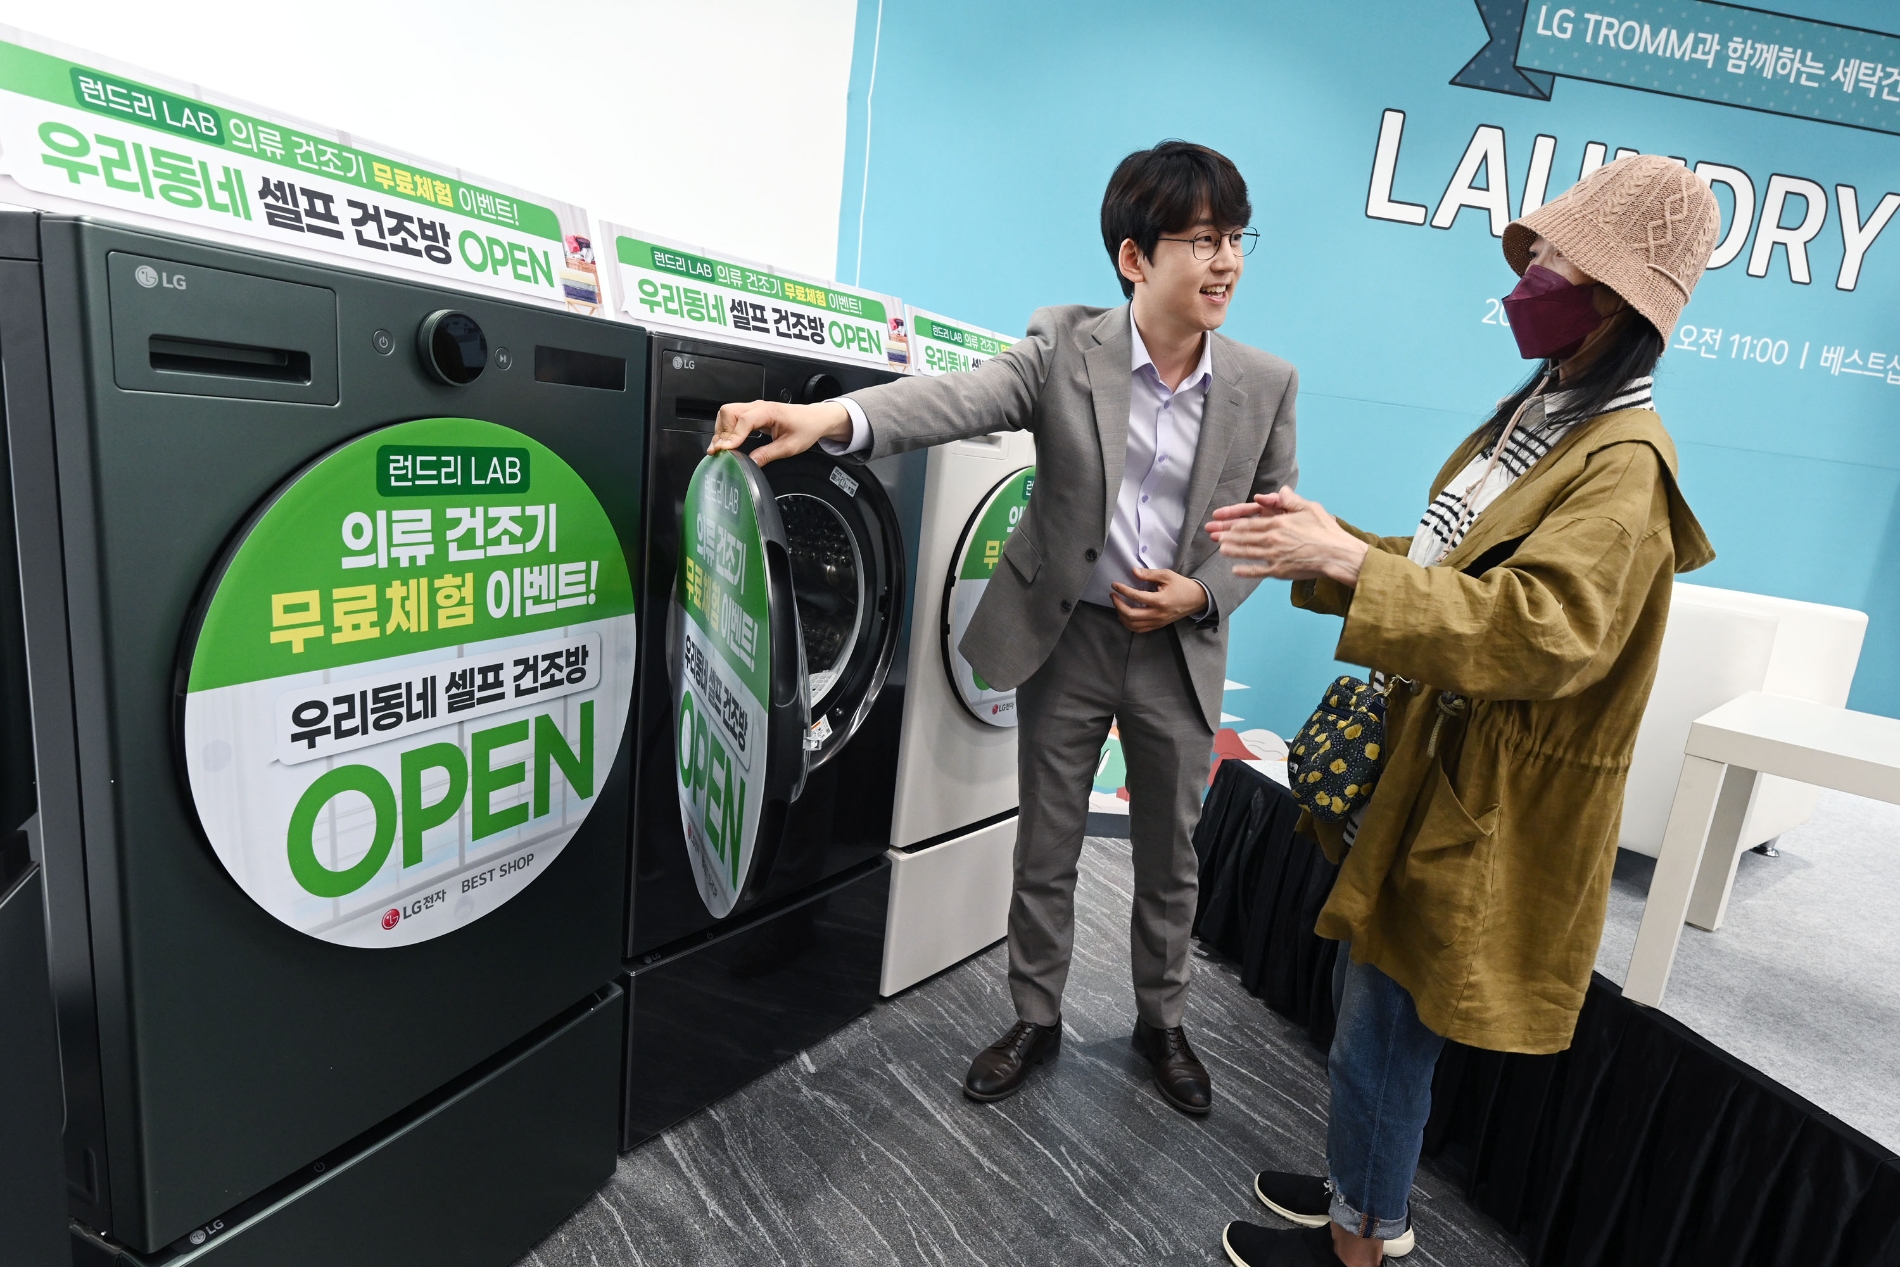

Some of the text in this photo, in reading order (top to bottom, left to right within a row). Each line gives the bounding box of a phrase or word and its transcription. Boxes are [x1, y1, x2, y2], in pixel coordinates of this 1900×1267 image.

[1536, 4, 1576, 40] LG
[1583, 12, 1721, 70] TROMM과
[1726, 36, 1826, 88] 함께하는
[78, 75, 520, 226] 런드리 LAB 의류 건조기 무료체험 이벤트!
[37, 120, 556, 289] 우리동네 셀프 건조방 OPEN
[1365, 108, 1900, 292] LADRY
[162, 271, 187, 290] LG
[653, 250, 863, 316] 런드리 LAB 의류 건조기 무료체험 이벤트!
[637, 277, 883, 356] 우리동네 셀프 건조방 OPEN
[949, 329, 963, 344] LAB
[964, 333, 979, 350] 의류
[979, 337, 1000, 354] 건조기
[1673, 324, 1722, 361] 오전
[1728, 332, 1790, 366] 11:00
[683, 359, 695, 370] LG
[924, 344, 970, 373] 우리동네
[388, 454, 522, 488] 런드리 LAB
[724, 482, 739, 515] LAB
[340, 502, 558, 570] 의류 건조기
[696, 511, 747, 596] 의류 건조기
[268, 559, 599, 654] 무료체험 이벤트!
[685, 556, 759, 674] 무료체험 이벤트!
[290, 643, 590, 750] 우리동네 셀프 건조방
[722, 685, 749, 753] 건조방
[286, 698, 596, 899] OPEN
[678, 689, 746, 893] OPEN
[402, 853, 535, 920] LG전자 BEST SHOP
[205, 1219, 225, 1236] LG
